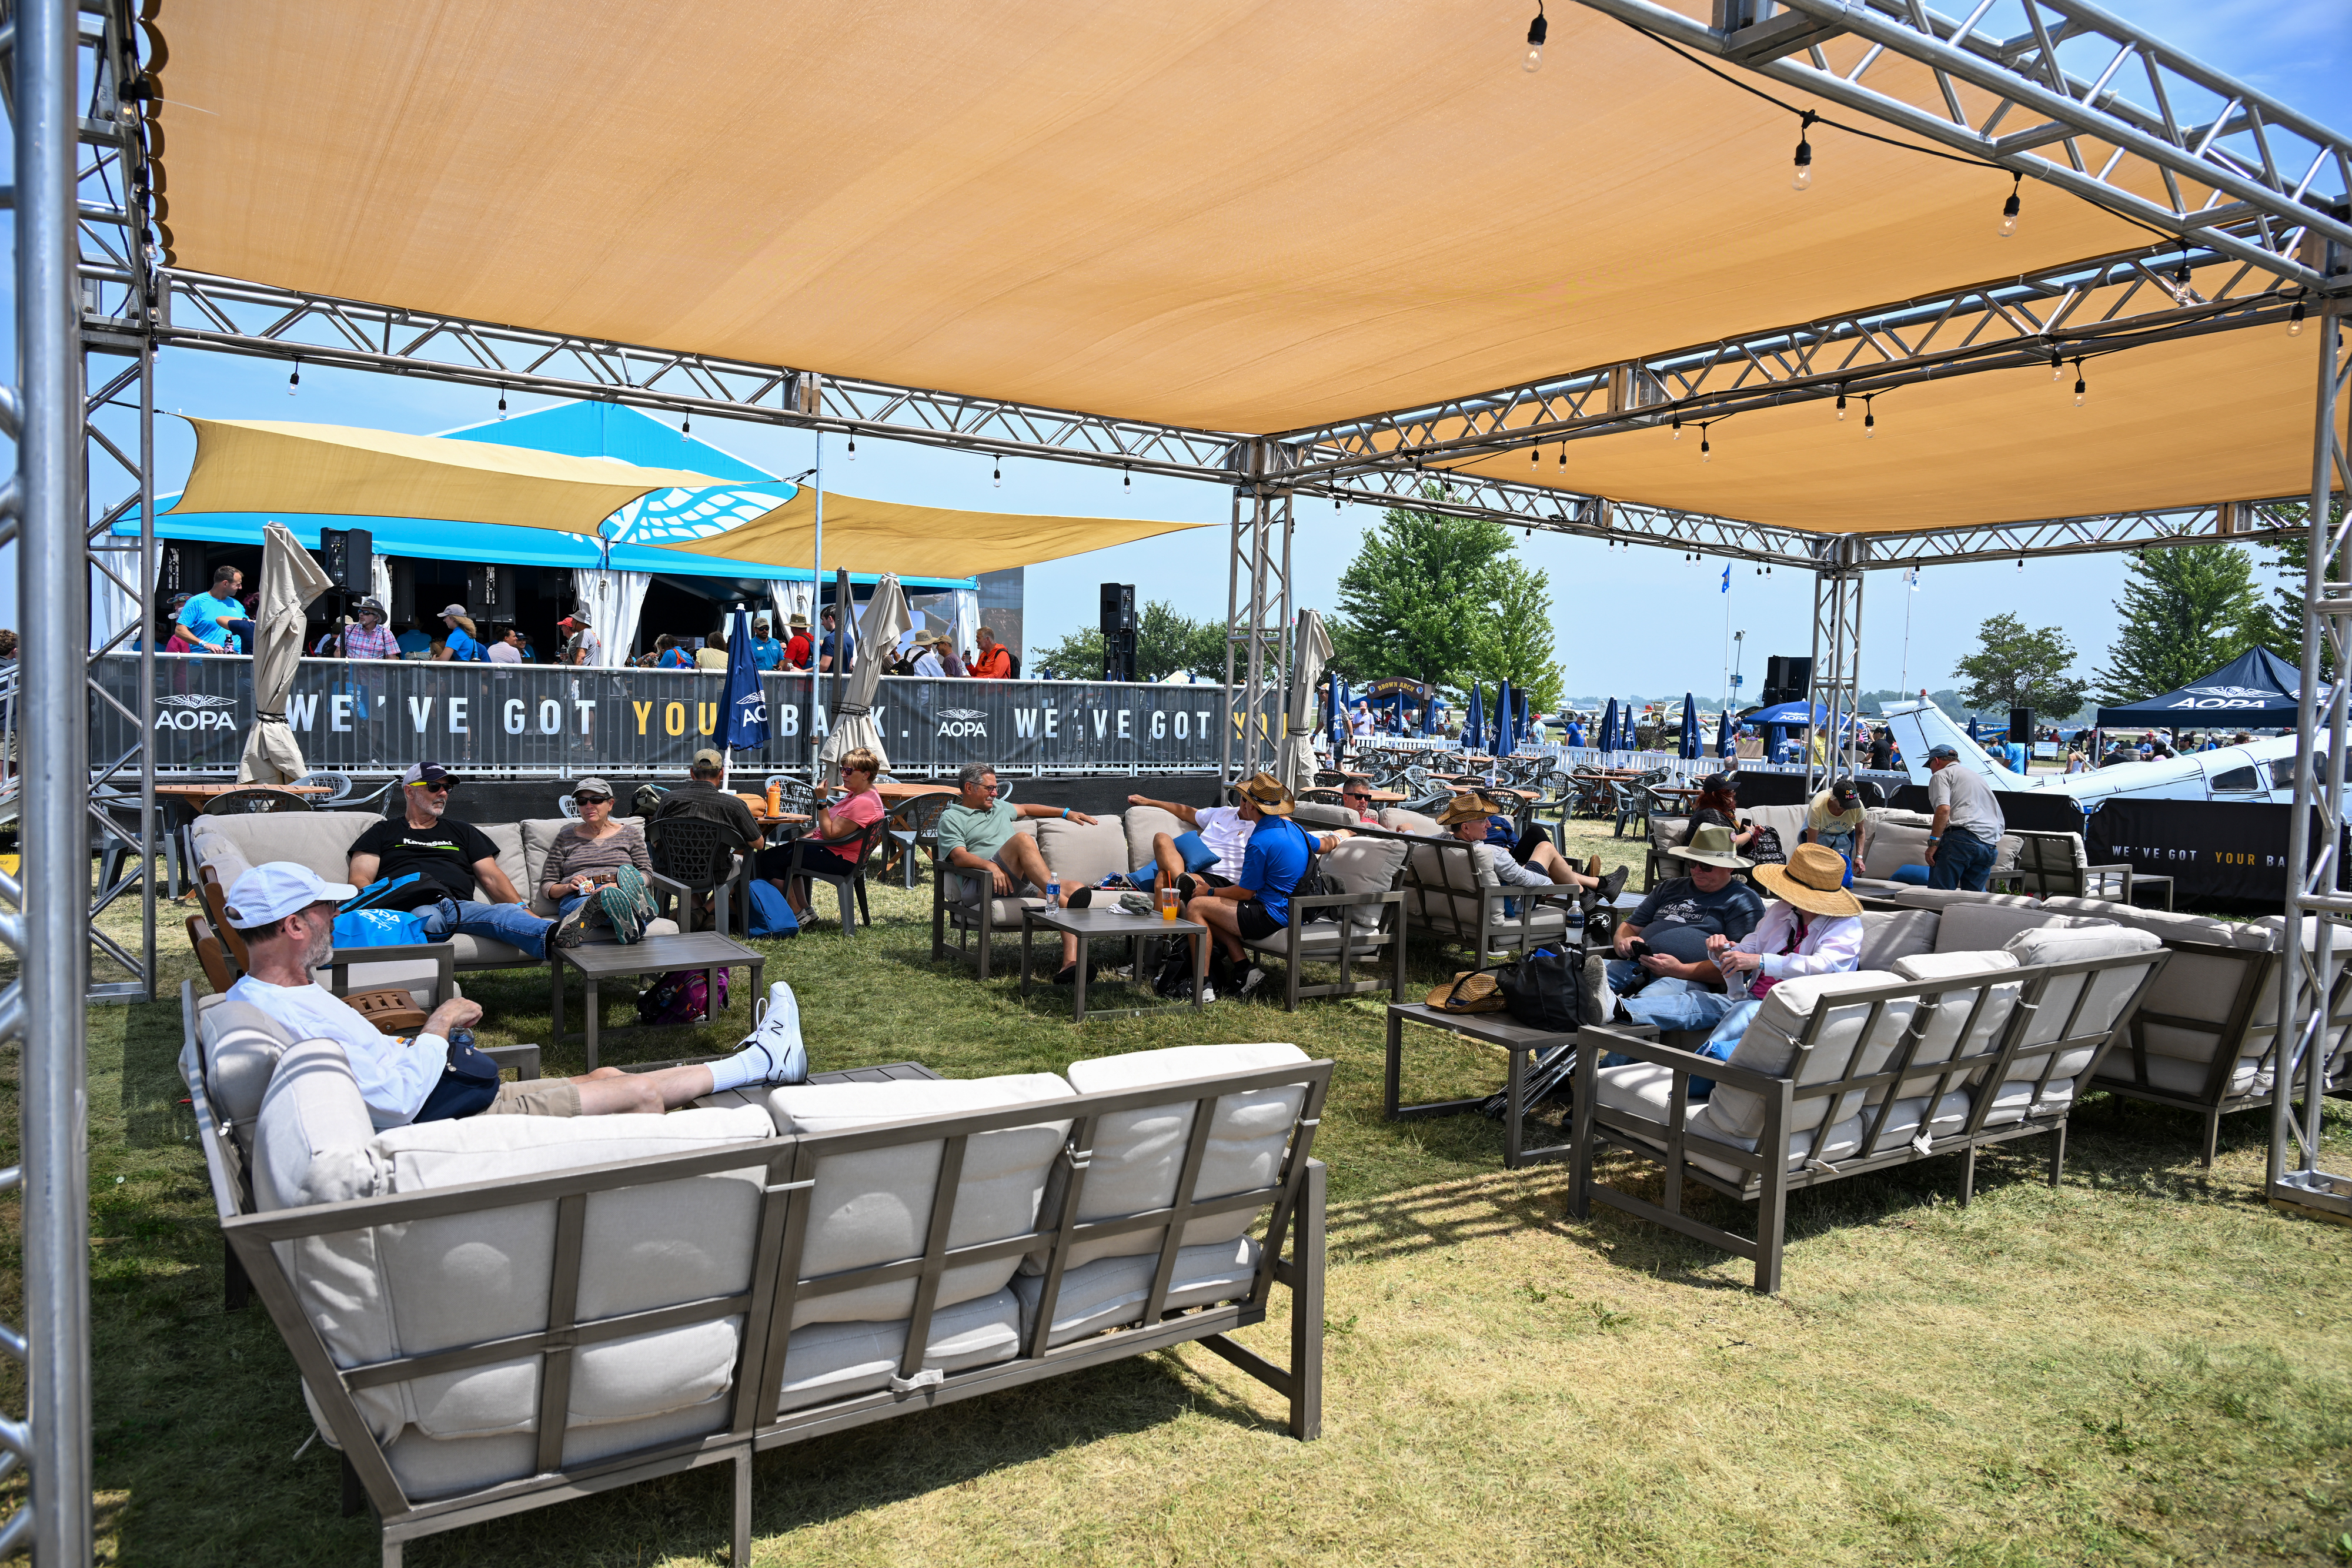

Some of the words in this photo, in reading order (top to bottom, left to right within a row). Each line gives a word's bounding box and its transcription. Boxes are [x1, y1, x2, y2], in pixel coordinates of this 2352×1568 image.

[1377, 681, 1398, 691] BROWN
[1399, 682, 1415, 693] ARCH
[2167, 697, 2265, 708] AOPA
[155, 710, 237, 730] AOPA
[504, 698, 596, 735] GOT
[632, 701, 717, 736] YOU
[781, 704, 908, 737] BAK.
[1015, 708, 1130, 738] WE'VE
[1151, 710, 1211, 740] GOT
[937, 721, 987, 737] AOPA
[1821, 821, 1840, 834] HKOSH
[403, 838, 453, 847] Kawasaki
[2112, 845, 2160, 859] WE'VE
[2168, 849, 2197, 861] GOT
[2215, 852, 2256, 865] YOUR
[2266, 855, 2286, 868] BA
